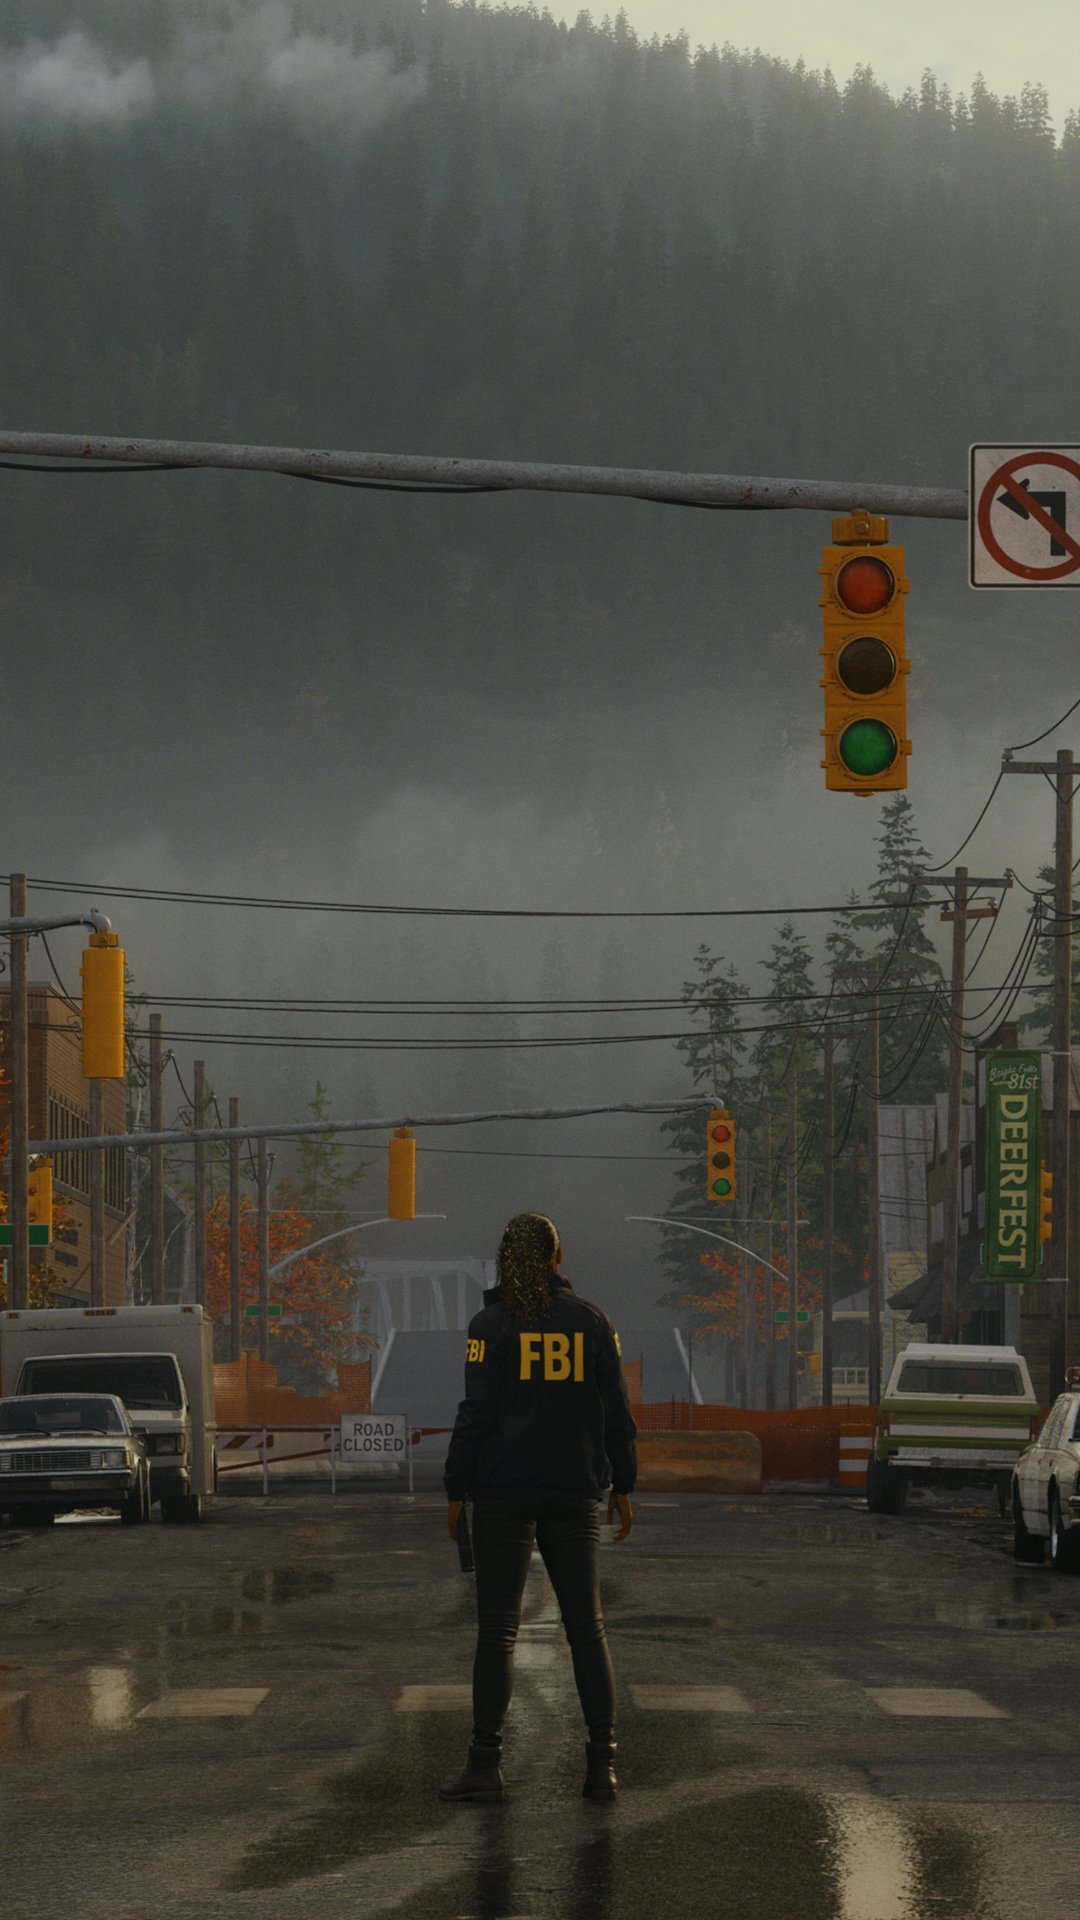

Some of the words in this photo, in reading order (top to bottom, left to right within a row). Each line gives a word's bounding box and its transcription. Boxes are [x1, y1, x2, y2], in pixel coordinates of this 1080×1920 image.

[1008, 1073, 1040, 1089] 81st
[998, 1094, 1029, 1269] DEERFEST
[519, 1332, 584, 1382] FBI
[353, 1423, 394, 1436] ROAD
[343, 1438, 404, 1452] CLOSED
